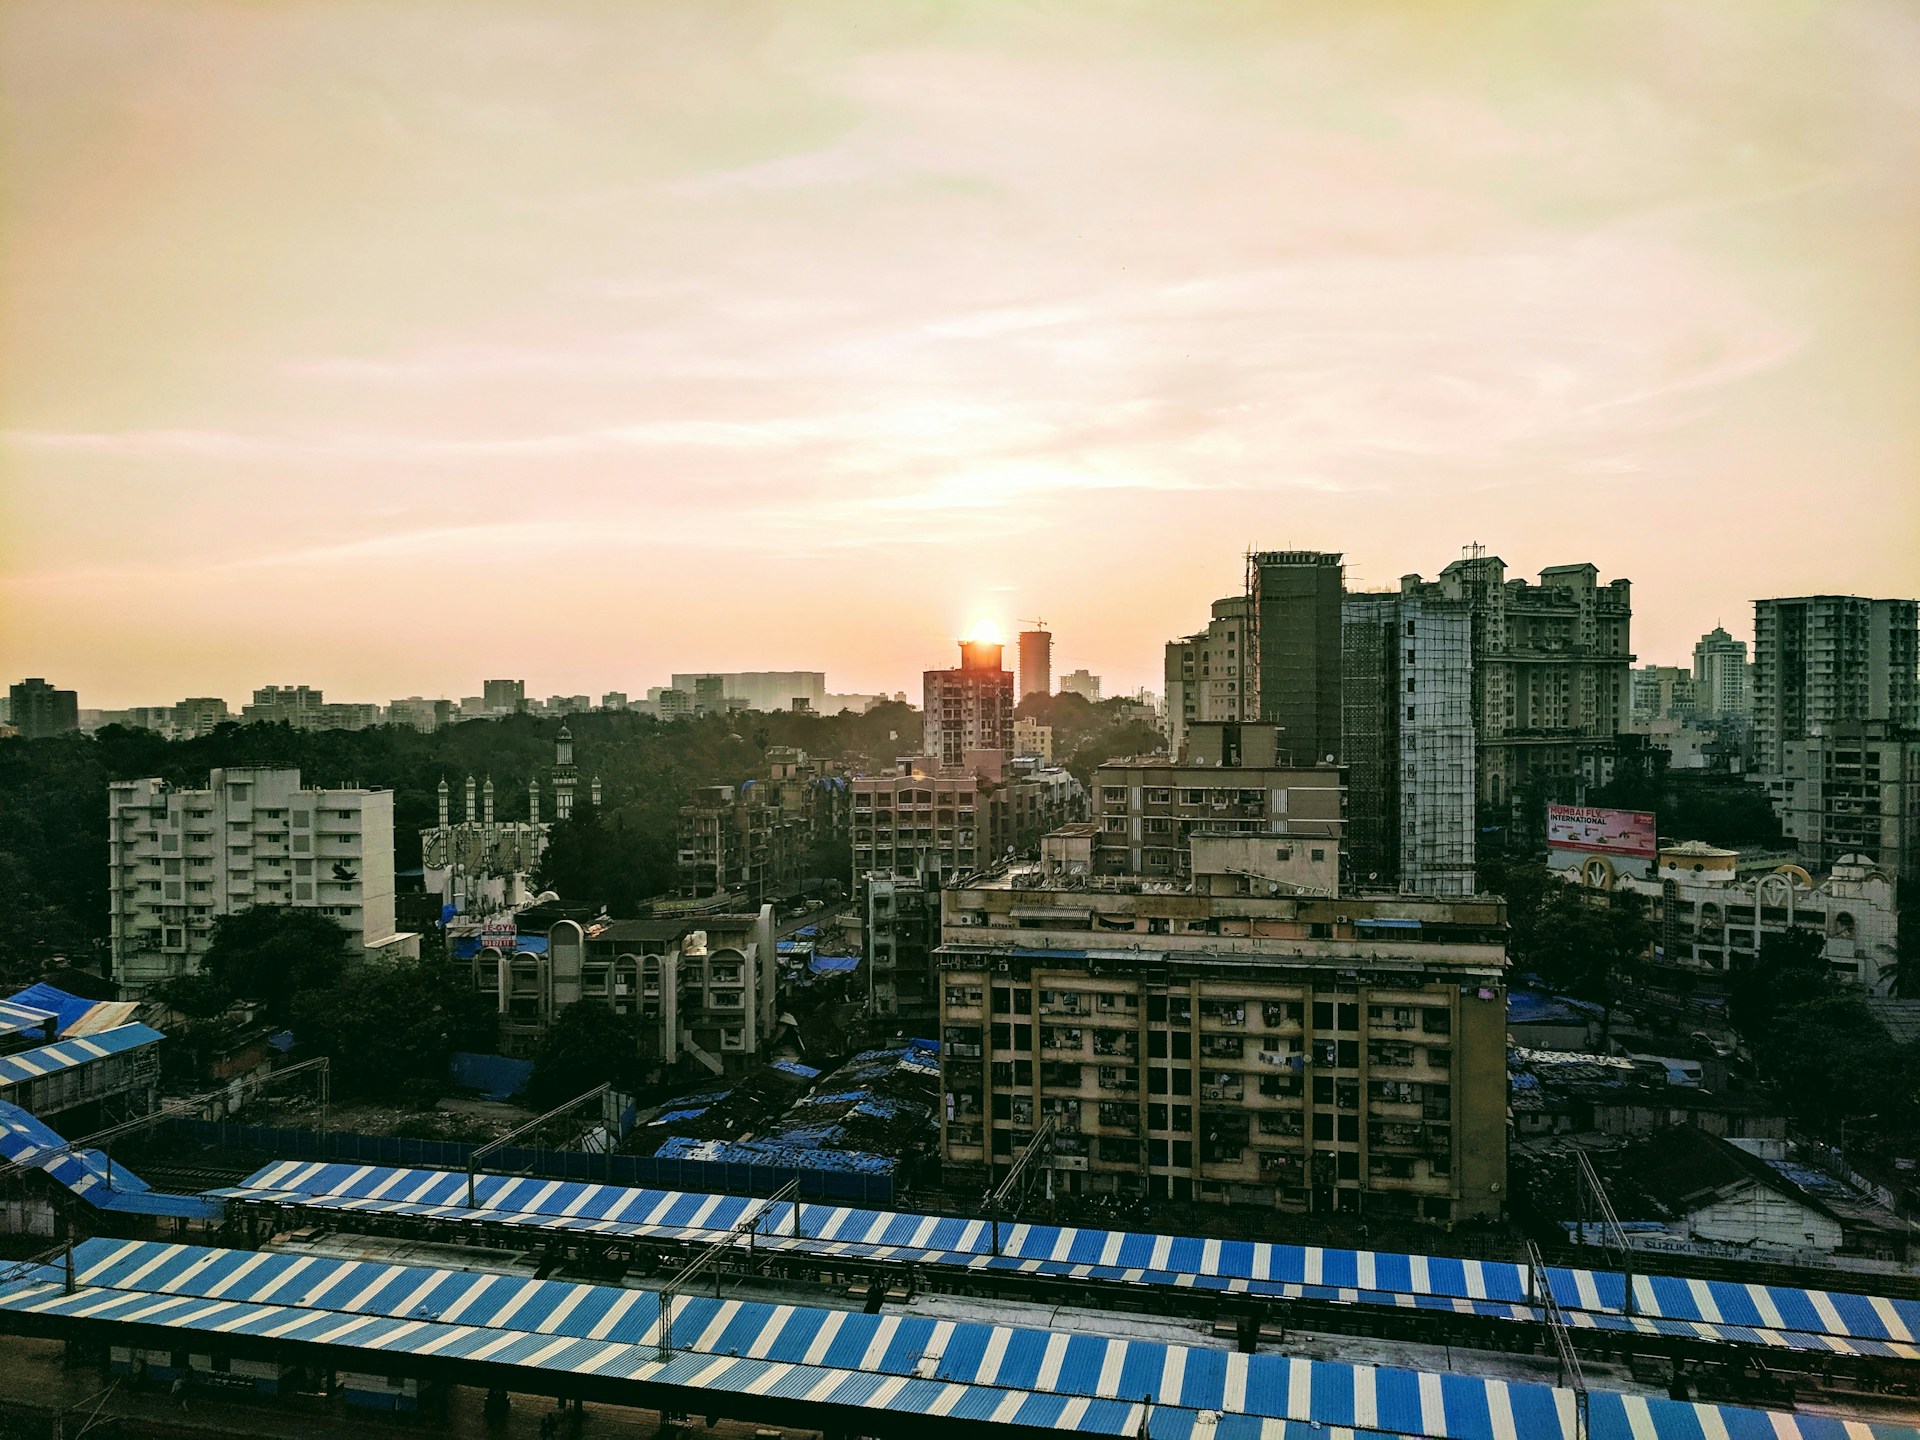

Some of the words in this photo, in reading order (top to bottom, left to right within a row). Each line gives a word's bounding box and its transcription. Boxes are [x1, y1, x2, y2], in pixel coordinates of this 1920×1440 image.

[1551, 807, 1583, 816] MUMBAI
[1586, 809, 1601, 818] FLY
[1550, 814, 1607, 825] INTERNATIONAL
[1643, 1239, 1691, 1252] SUZUKI
